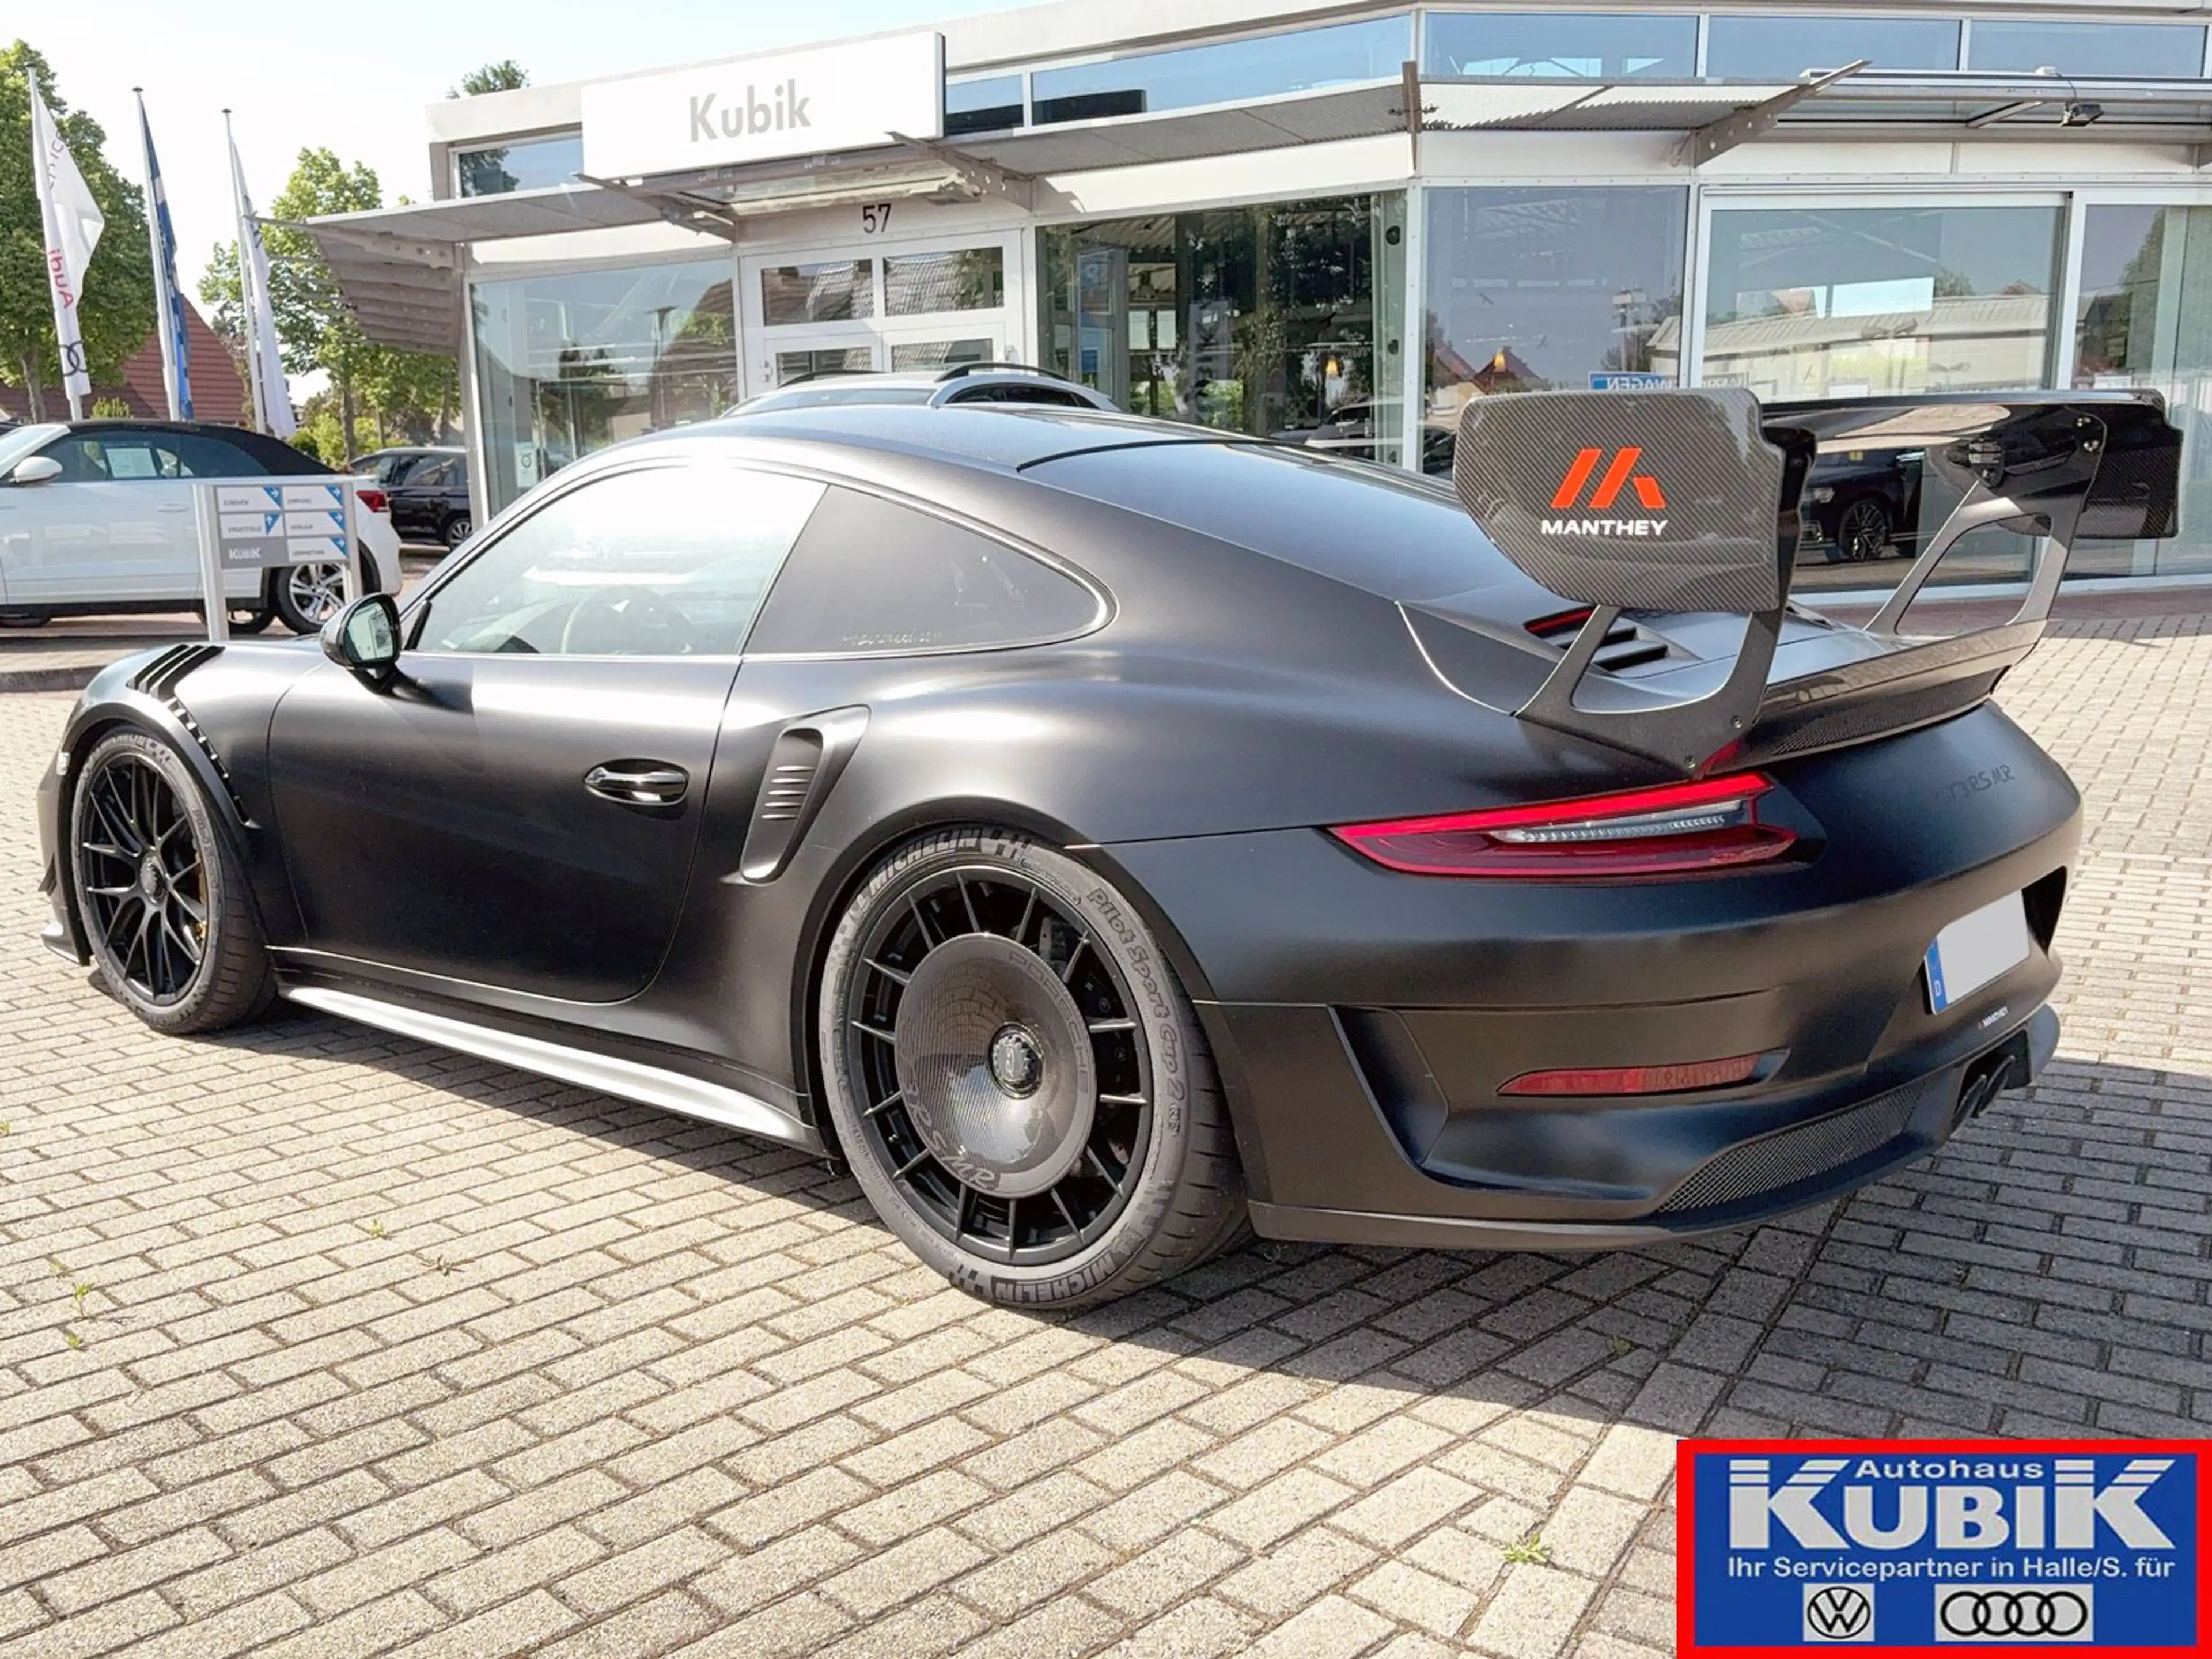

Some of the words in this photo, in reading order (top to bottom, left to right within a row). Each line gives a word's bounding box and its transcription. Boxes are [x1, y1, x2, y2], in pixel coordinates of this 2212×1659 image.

[690, 78, 811, 142] Kubik
[862, 204, 891, 233] 57
[1541, 520, 1669, 536] MANTHEY
[869, 830, 982, 896] MICHELIN
[1087, 888, 1135, 944] Pilot
[1127, 945, 1170, 1018] Sport
[1933, 979, 1942, 997] D
[1008, 952, 1089, 1094] PORSCHE
[1160, 1023, 1181, 1074] Cup
[1167, 1078, 1185, 1101] 2
[995, 1252, 1116, 1303] MICHELIN
